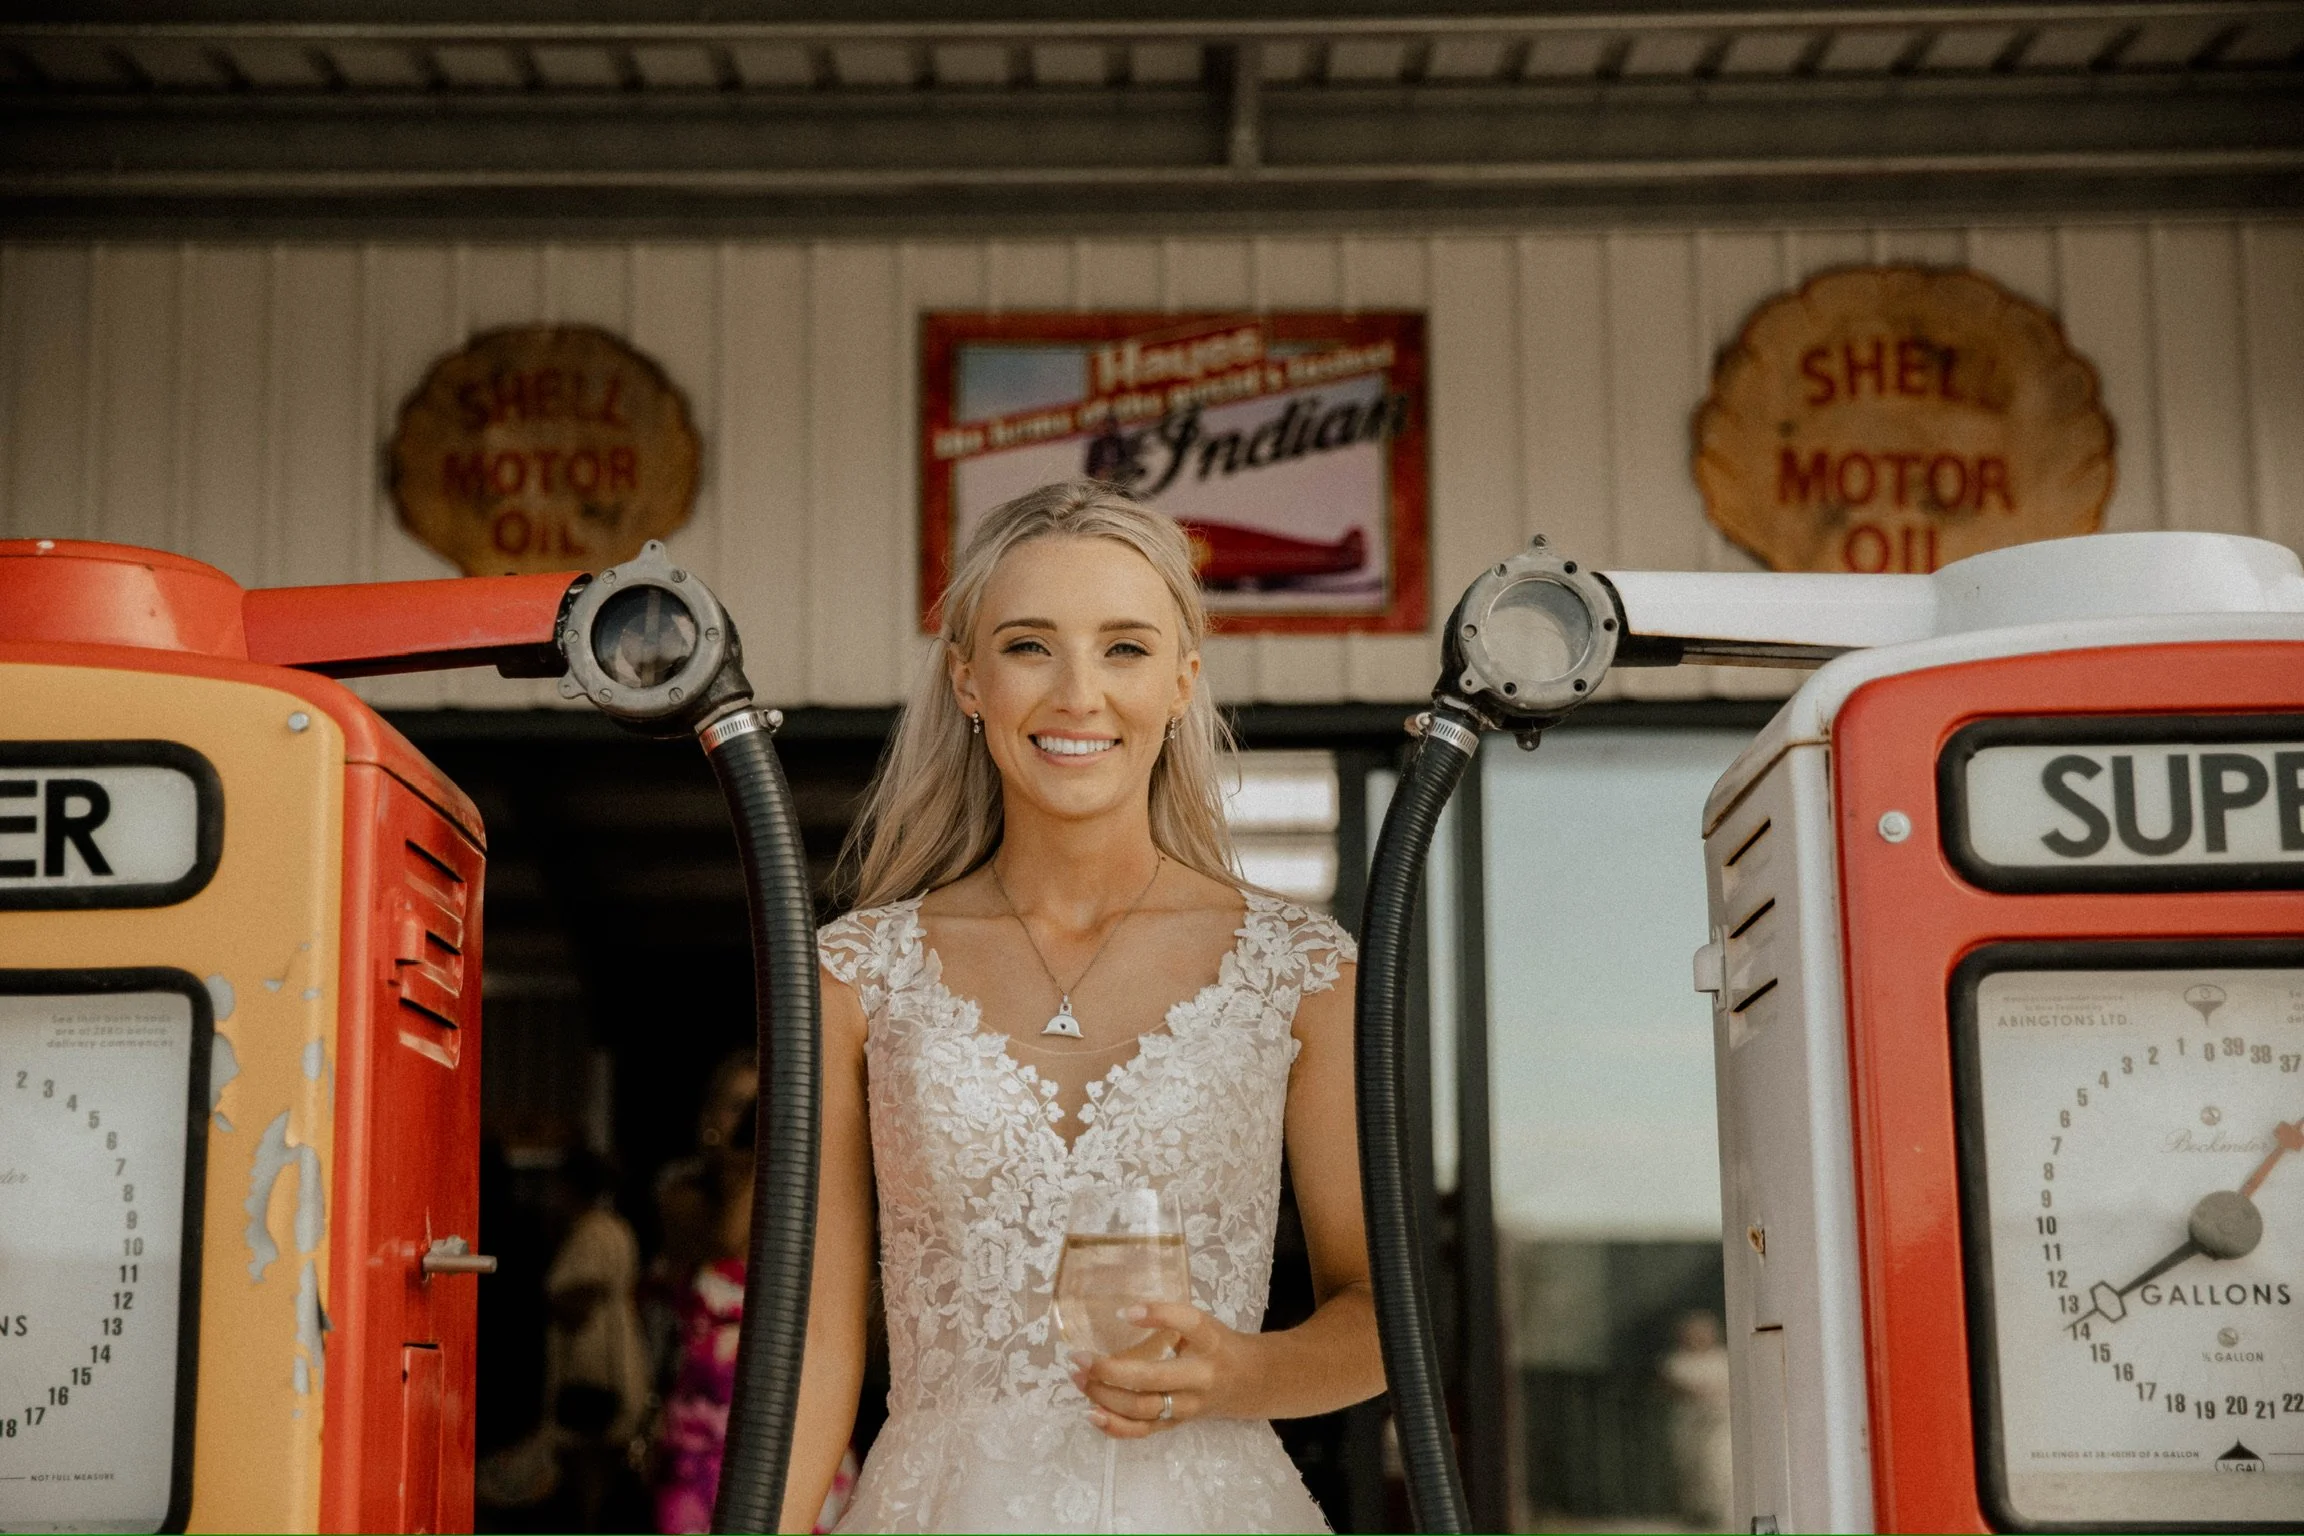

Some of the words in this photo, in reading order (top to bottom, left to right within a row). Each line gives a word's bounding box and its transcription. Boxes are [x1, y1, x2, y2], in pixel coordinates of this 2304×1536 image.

[457, 367, 630, 432] SHELL
[1138, 394, 1408, 499] Indian
[442, 445, 638, 500] MOTOR
[1778, 446, 2016, 513] MOTOR
[493, 509, 587, 557] OIL
[1998, 1014, 2095, 1027] ABINGTONS
[2147, 1045, 2159, 1066] 2
[2176, 1036, 2186, 1056] 1
[2203, 1042, 2216, 1063] 0
[2221, 1036, 2245, 1057] 39
[2250, 1044, 2273, 1065] 38
[2121, 1055, 2134, 1075] 3
[2279, 1053, 2302, 1073] 37
[16, 1069, 29, 1090] 2
[42, 1078, 55, 1099] 3
[2098, 1070, 2110, 1089] 4
[66, 1093, 78, 1112] 4
[2076, 1087, 2089, 1108] 5
[88, 1109, 101, 1130] 5
[2059, 1109, 2072, 1129] 6
[105, 1130, 118, 1151] 6
[2050, 1135, 2063, 1156] 7
[115, 1157, 127, 1177] 7
[2042, 1161, 2055, 1182] 8
[122, 1183, 135, 1203] 8
[2040, 1189, 2053, 1209] 9
[126, 1210, 138, 1230] 9
[2036, 1215, 2058, 1236] 10
[124, 1237, 144, 1257] 10
[2042, 1242, 2062, 1262] 11
[119, 1263, 138, 1284] 11
[2047, 1269, 2068, 1289] 12
[113, 1291, 134, 1311] 12
[2059, 1295, 2080, 1315] 13
[2140, 1284, 2291, 1306] GALLONS
[102, 1316, 123, 1337] 13
[2070, 1322, 2091, 1341] 14
[90, 1344, 112, 1364] 14
[2090, 1342, 2112, 1364] 15
[2214, 1351, 2264, 1363] GALLON
[71, 1366, 92, 1386] 15
[2113, 1362, 2135, 1382] 16
[48, 1385, 70, 1406] 16
[2136, 1381, 2157, 1402] 17
[2165, 1393, 2187, 1414] 18
[2195, 1400, 2217, 1420] 19
[2225, 1395, 2249, 1416] 20
[2255, 1400, 2276, 1420] 21
[2282, 1392, 2304, 1413] 22
[24, 1406, 46, 1426] 17
[2162, 1450, 2199, 1458] GALLON
[30, 1474, 50, 1482] NOT
